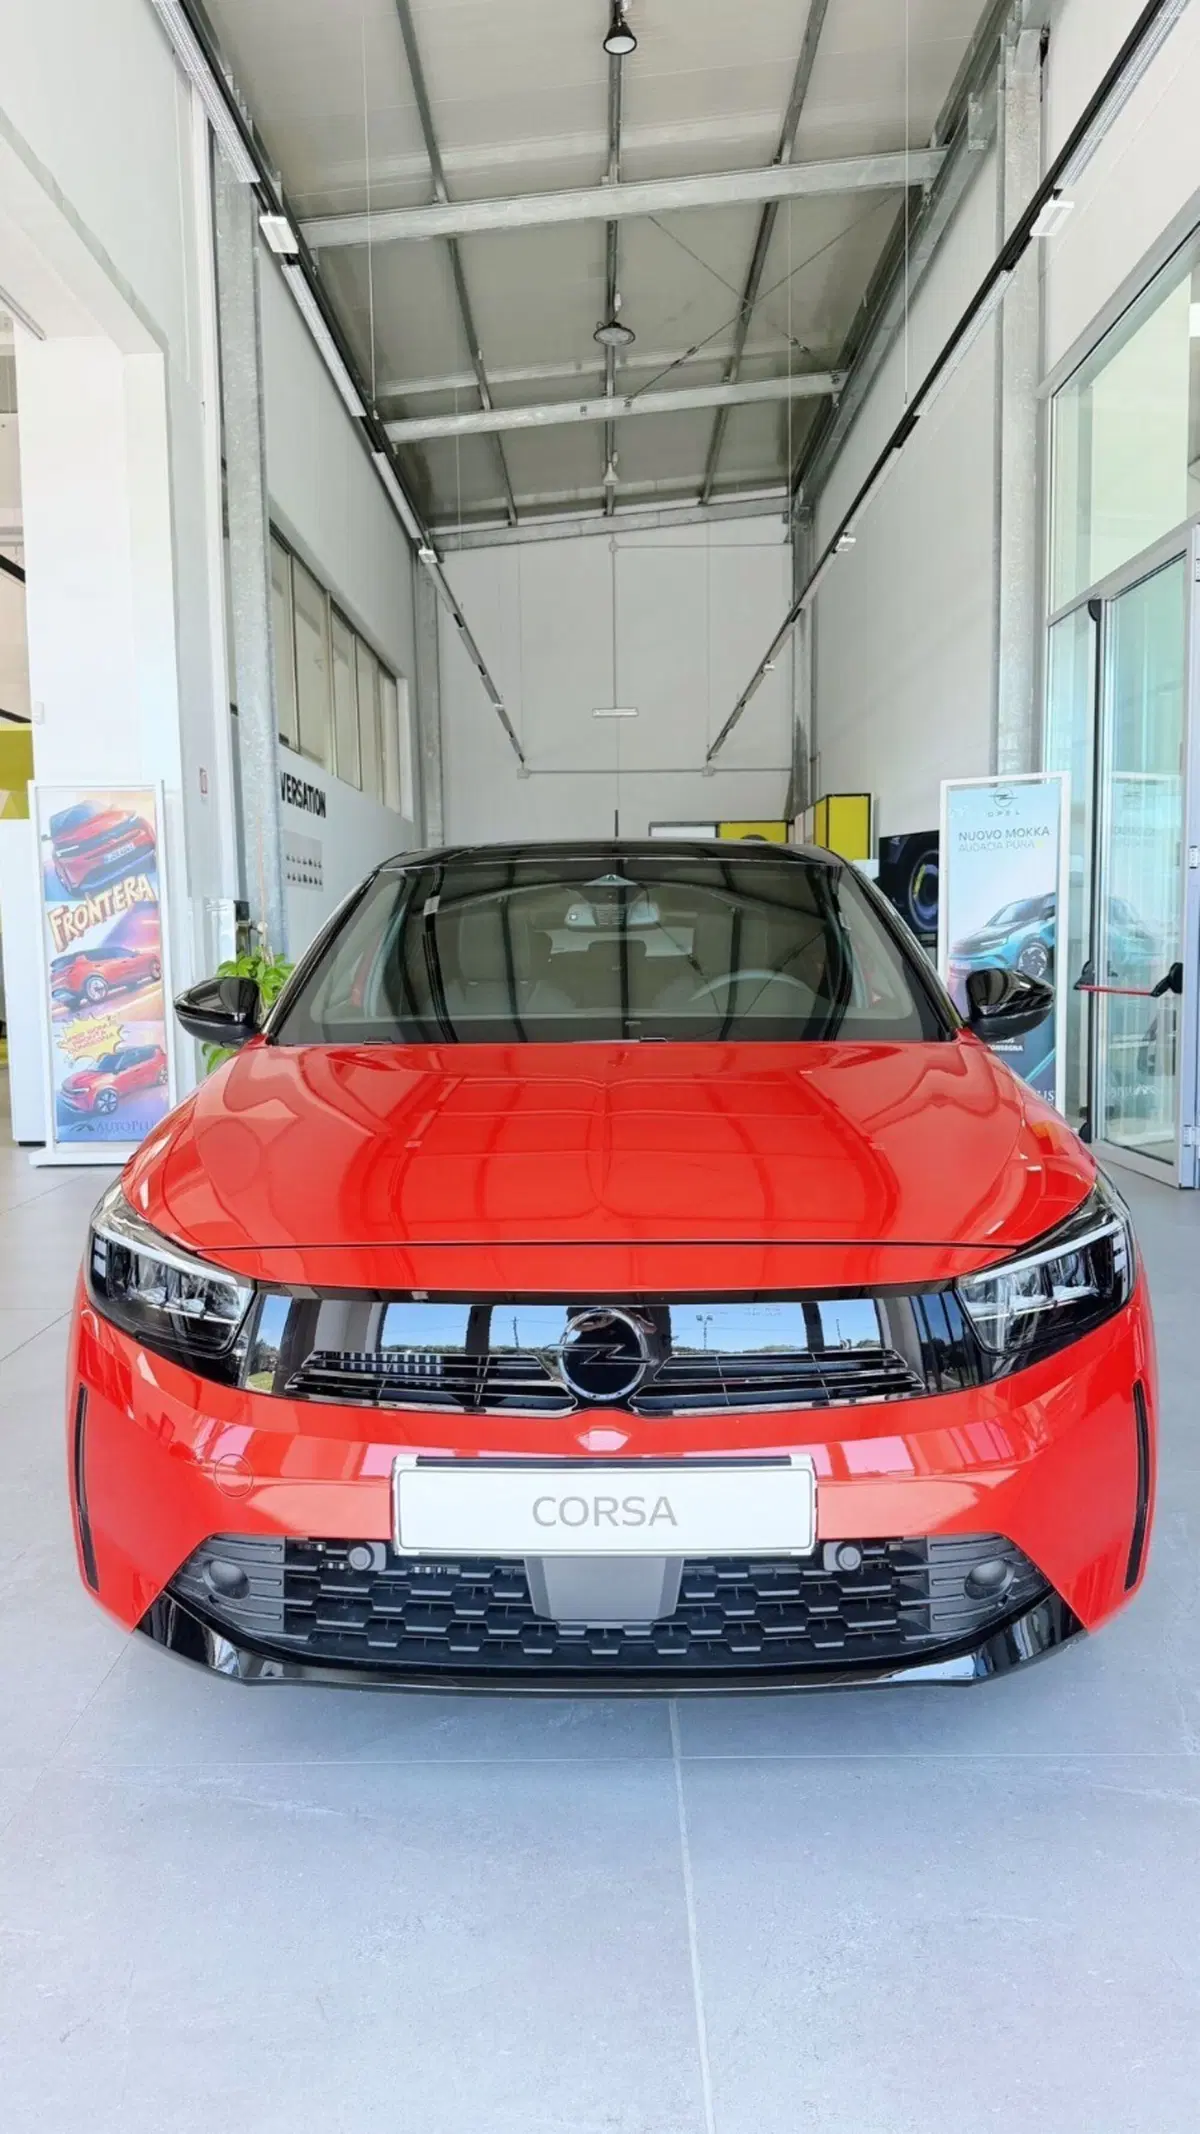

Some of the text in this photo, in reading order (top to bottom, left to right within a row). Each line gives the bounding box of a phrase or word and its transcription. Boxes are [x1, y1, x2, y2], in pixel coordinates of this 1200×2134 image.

[281, 770, 326, 818] VERSATION
[987, 809, 1020, 818] OPEL
[958, 825, 1050, 841] NUOVO MOKKA
[48, 872, 156, 953] FRONTERA
[96, 1119, 157, 1133] AUTOPLU
[532, 1496, 678, 1527] CORSA
